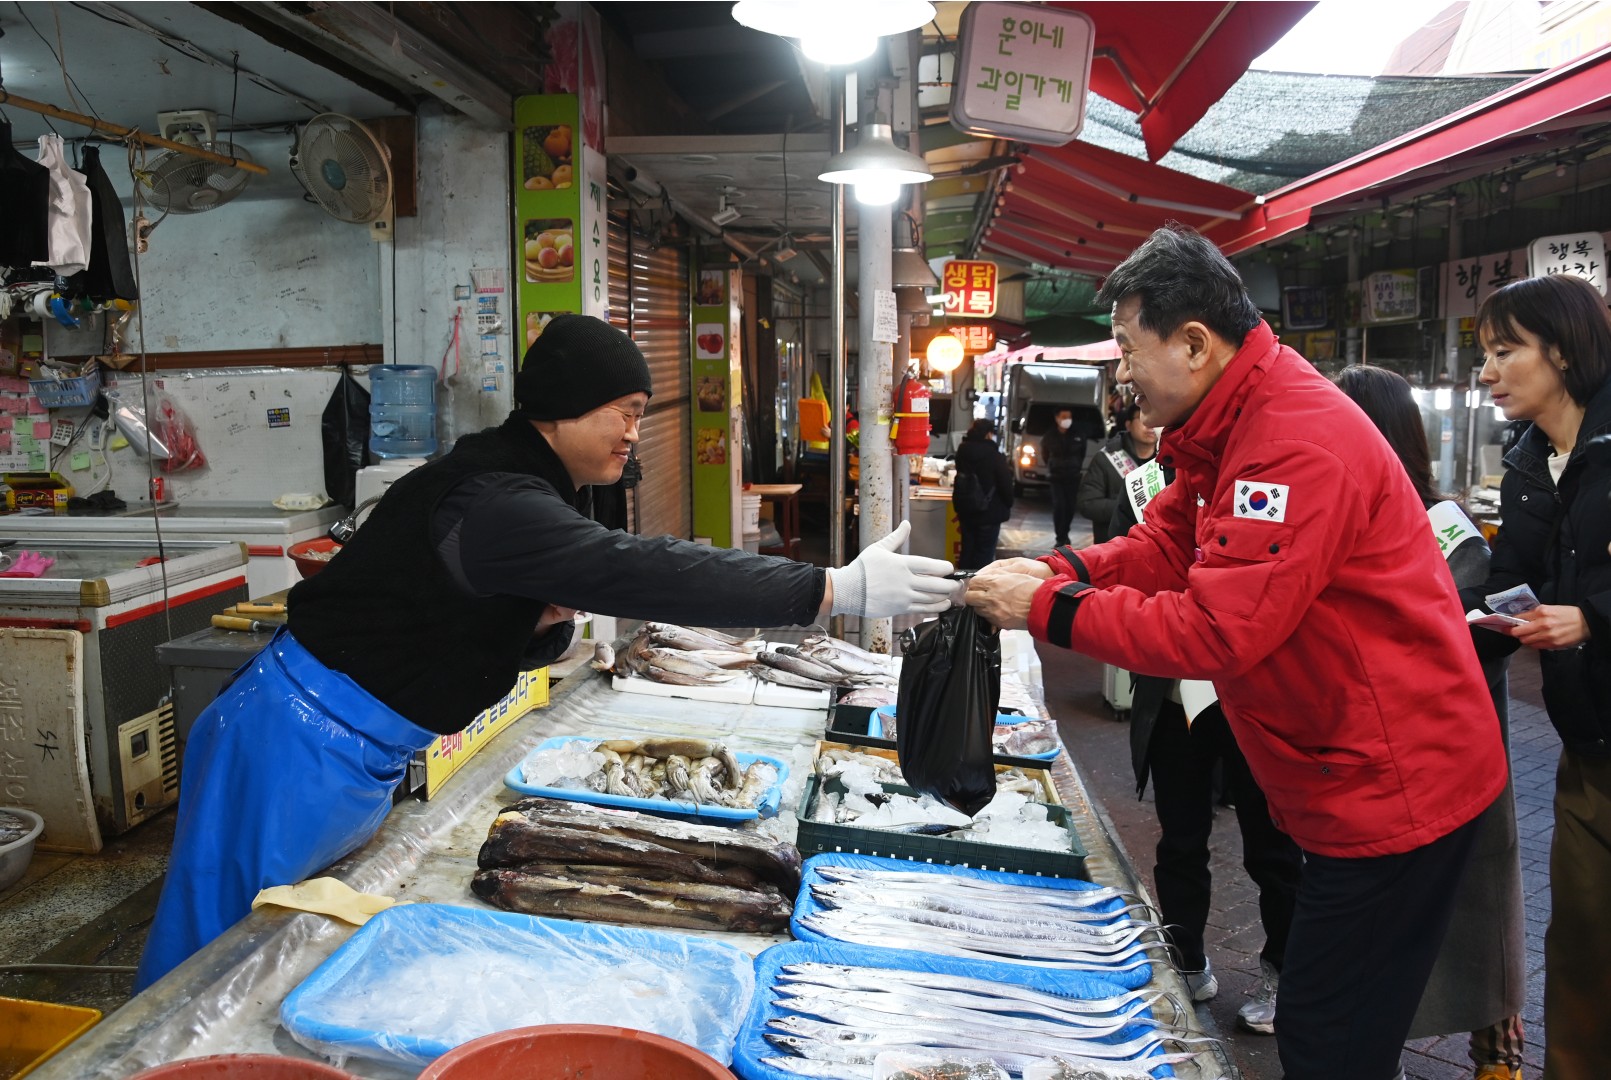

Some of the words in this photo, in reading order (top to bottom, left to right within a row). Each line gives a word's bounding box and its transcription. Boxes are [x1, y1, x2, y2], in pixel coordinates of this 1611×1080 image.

[998, 17, 1064, 56] 훈이네
[976, 66, 1073, 111] 과일가게
[1548, 240, 1594, 261] 행복
[945, 264, 994, 289] 생닭
[944, 289, 993, 314] 어묵
